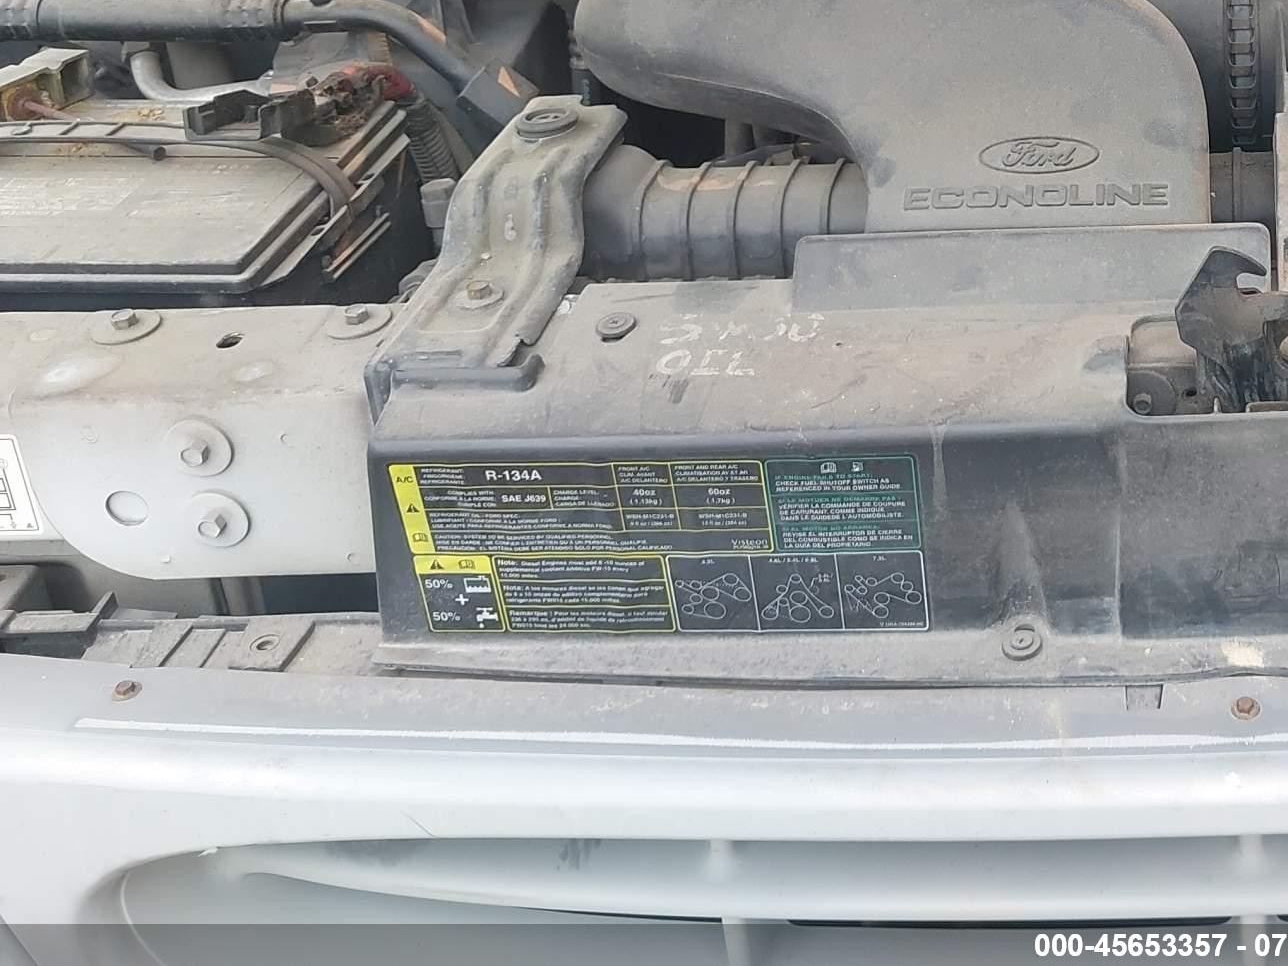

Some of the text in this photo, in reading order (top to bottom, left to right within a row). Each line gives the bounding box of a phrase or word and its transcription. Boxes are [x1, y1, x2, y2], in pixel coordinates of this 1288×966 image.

[1002, 140, 1078, 167] Ford
[903, 184, 1168, 211] ECONOLINE
[396, 476, 414, 484] A/C
[485, 469, 543, 482] R-134A
[633, 488, 656, 496] 40oz
[708, 488, 731, 496] 60oz
[501, 494, 546, 503] SAE J639
[424, 578, 453, 589] 50%
[432, 611, 461, 622] 50%
